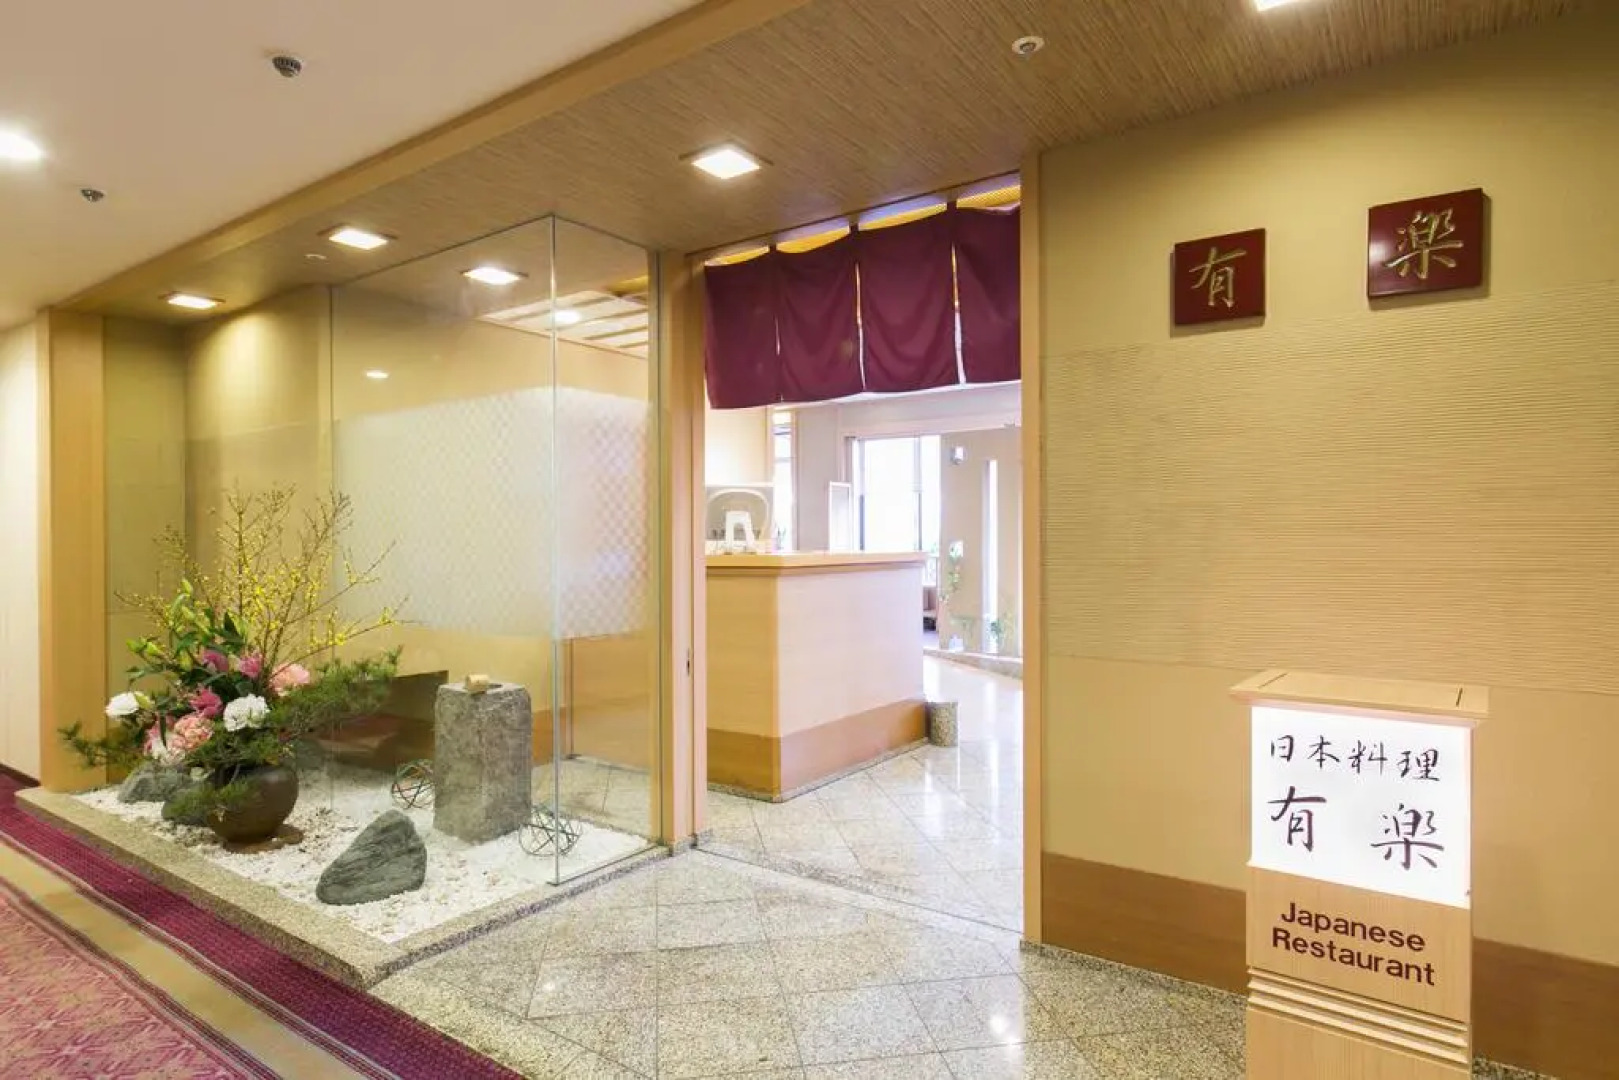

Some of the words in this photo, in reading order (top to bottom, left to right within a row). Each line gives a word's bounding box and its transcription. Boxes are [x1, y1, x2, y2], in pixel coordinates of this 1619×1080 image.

[1189, 246, 1247, 308] 有
[1270, 734, 1440, 782] 日本料理
[1280, 902, 1426, 952] Japanese
[1272, 926, 1436, 987] Restaurant
